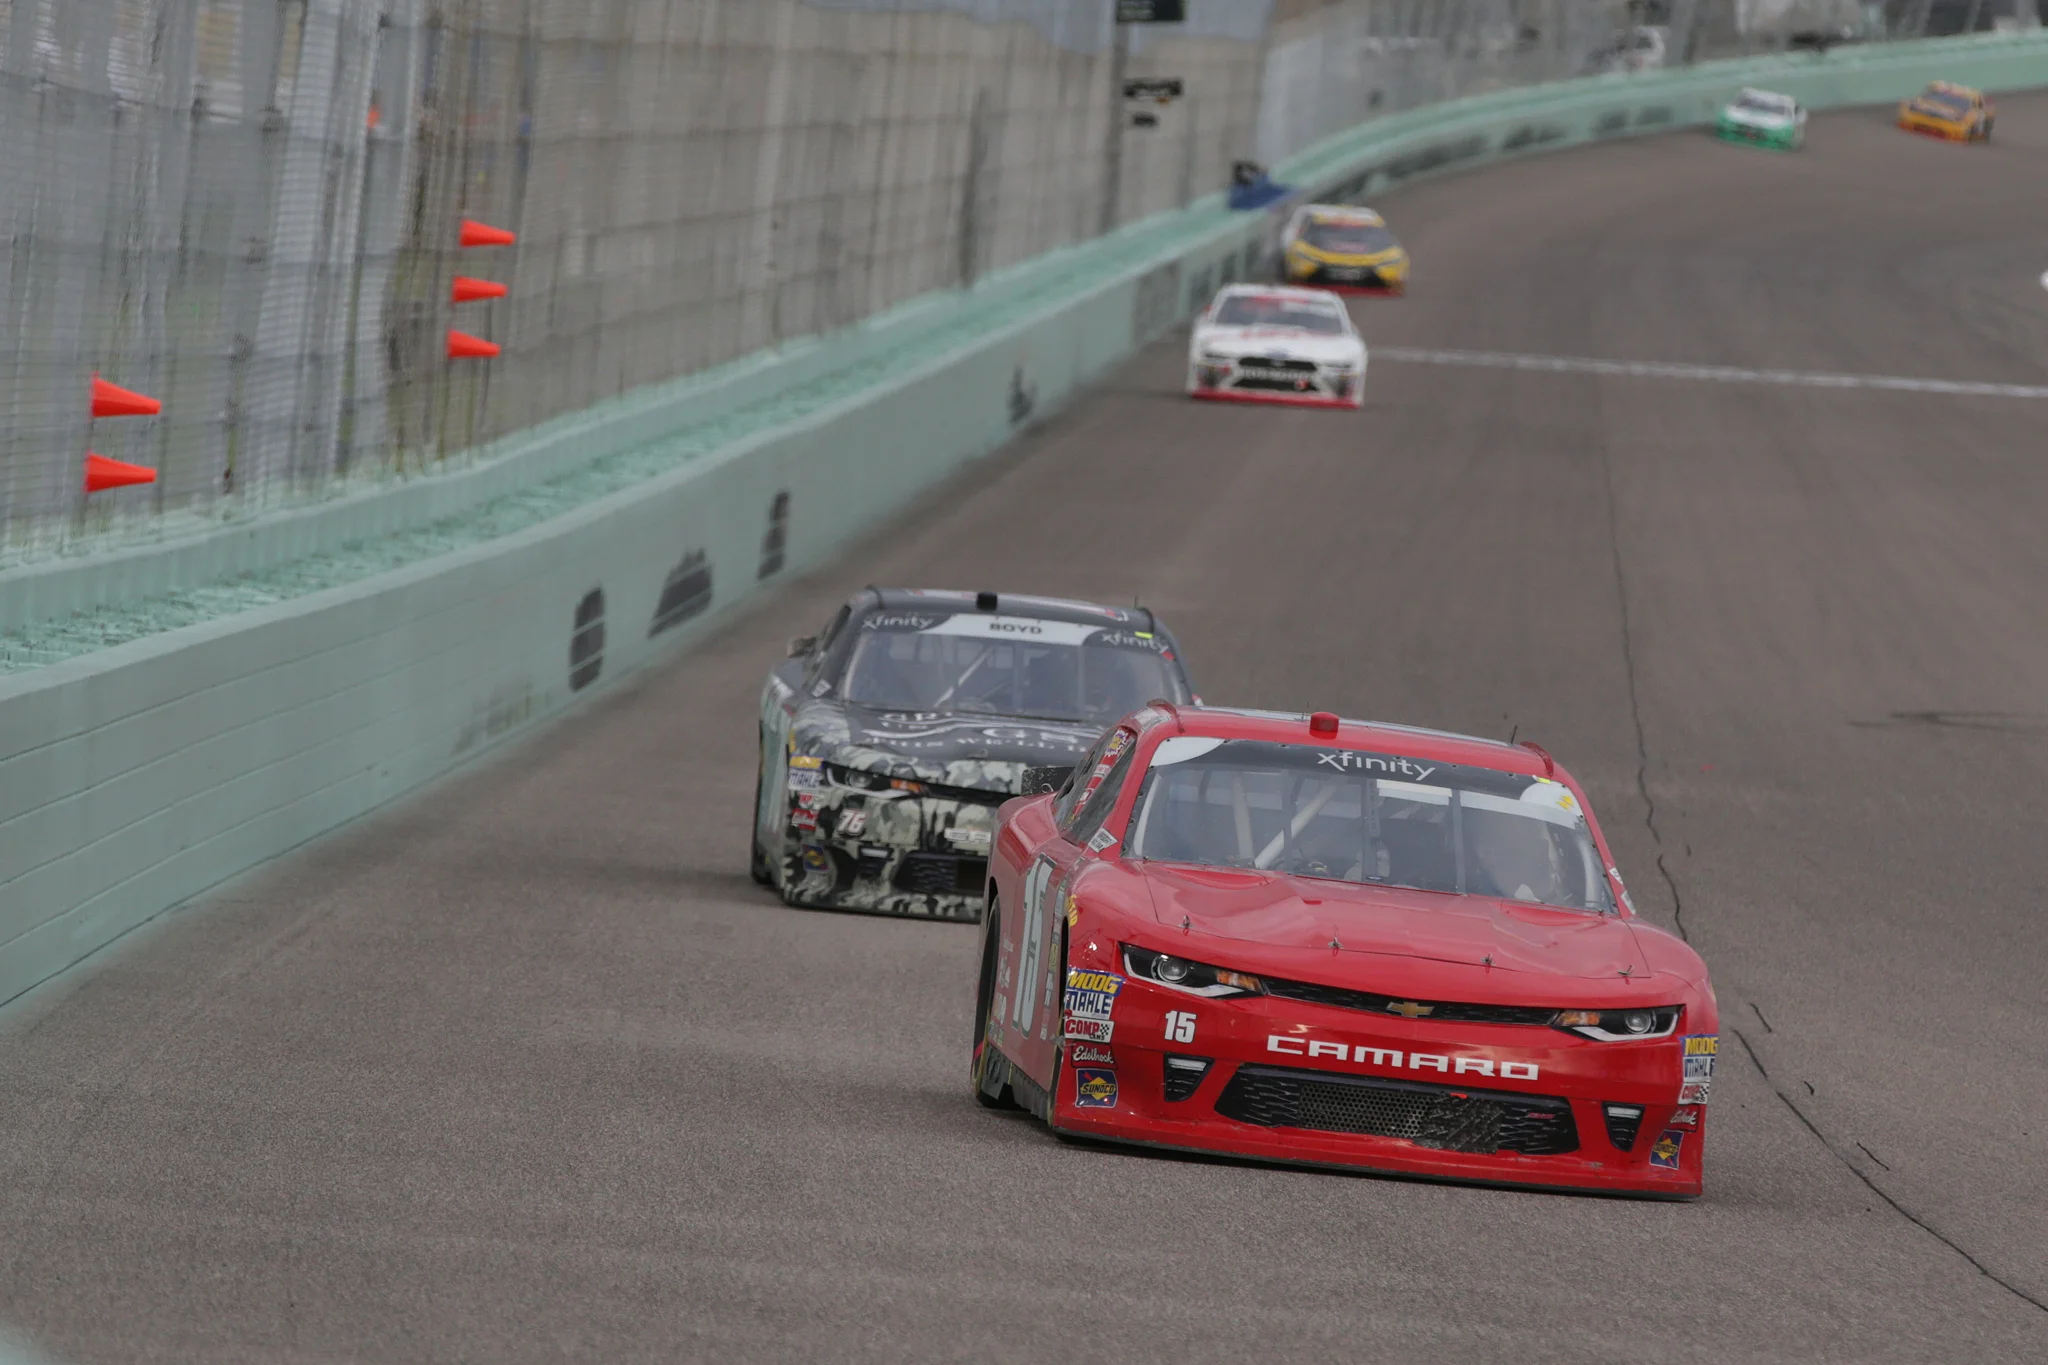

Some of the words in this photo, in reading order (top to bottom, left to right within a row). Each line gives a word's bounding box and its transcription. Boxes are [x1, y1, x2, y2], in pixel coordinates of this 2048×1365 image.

[862, 614, 934, 630] xfinity
[988, 622, 1043, 635] BOYD
[1317, 751, 1436, 781] xfinity
[838, 810, 868, 835] 76
[1068, 969, 1122, 994] MOOG
[1065, 1018, 1100, 1037] COMP
[1164, 1010, 1198, 1044] 15
[1266, 1034, 1540, 1081] CAMARO
[1081, 1082, 1116, 1095] SUNOCO
